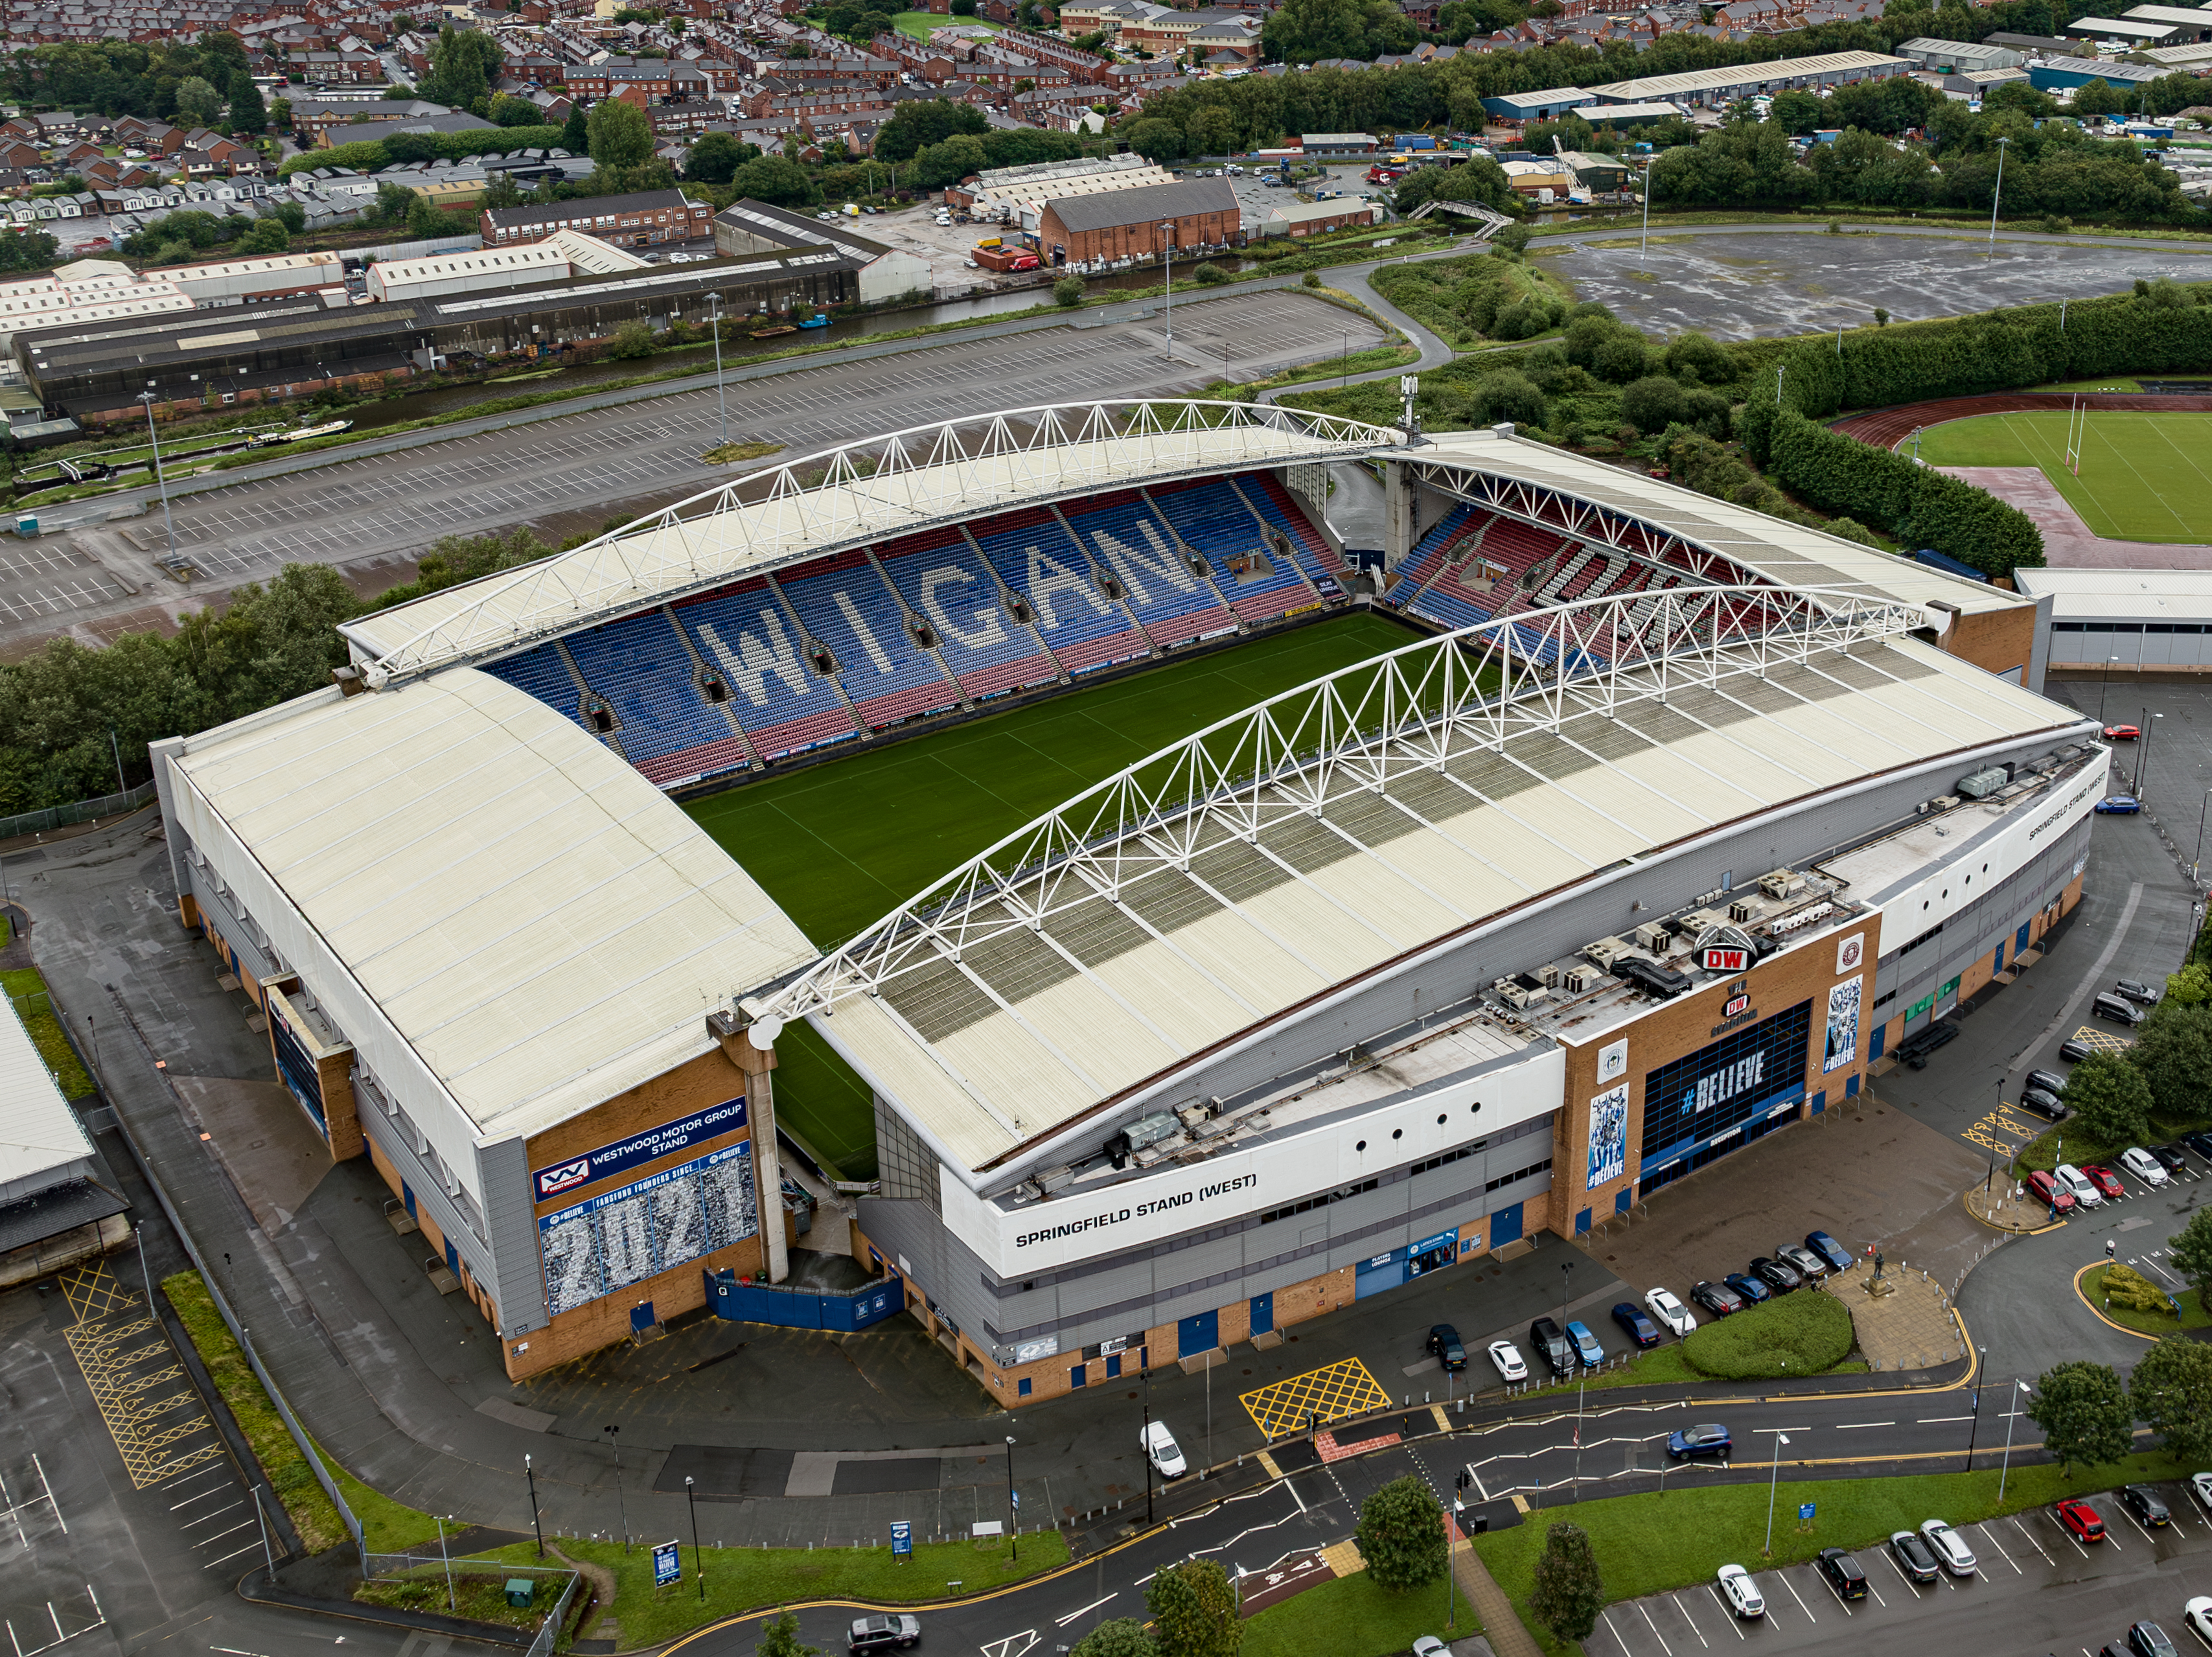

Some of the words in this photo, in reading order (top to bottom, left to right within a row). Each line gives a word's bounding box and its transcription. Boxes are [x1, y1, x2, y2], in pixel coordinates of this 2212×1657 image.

[1319, 585, 1339, 593] UNIQUE
[697, 519, 1197, 707] WIGAN
[766, 750, 788, 761] BETFRED
[789, 744, 811, 755] BETFRED
[2029, 804, 2068, 841] SPRINGFIELD
[2068, 787, 2087, 809] STAND
[2087, 771, 2106, 795] (WEST)
[1708, 951, 1744, 969] DW
[1727, 979, 1747, 997] THE
[1729, 997, 1745, 1015] DW
[1711, 1008, 1758, 1038] STADIUM
[1823, 1045, 1856, 1074] #BELIEVE
[1681, 1050, 1766, 1116] #BELIEVE
[592, 1134, 660, 1166] WESTWOOD
[662, 1118, 702, 1141] MOTOR
[704, 1104, 743, 1125] GROUP
[1710, 1126, 1742, 1147] RECEPTION
[651, 1134, 689, 1155] STAND
[718, 1146, 741, 1161] #BELIEVE
[1587, 1159, 1624, 1189] #BELIEVE
[548, 1176, 583, 1192] WESTWOOD
[595, 1187, 632, 1208] FANSFUND
[634, 1172, 670, 1194] FOUNDERS
[560, 1205, 584, 1222] #BELIEVE
[1016, 1208, 1131, 1248] SPRINGFIELD
[1136, 1191, 1193, 1218] STAND
[1199, 1173, 1258, 1202] (WEST)
[1433, 1234, 1444, 1244] STORE
[1371, 1257, 1391, 1268] LOUNGE
[1372, 1252, 1391, 1263] PLAYERS
[719, 1286, 728, 1296] Q
